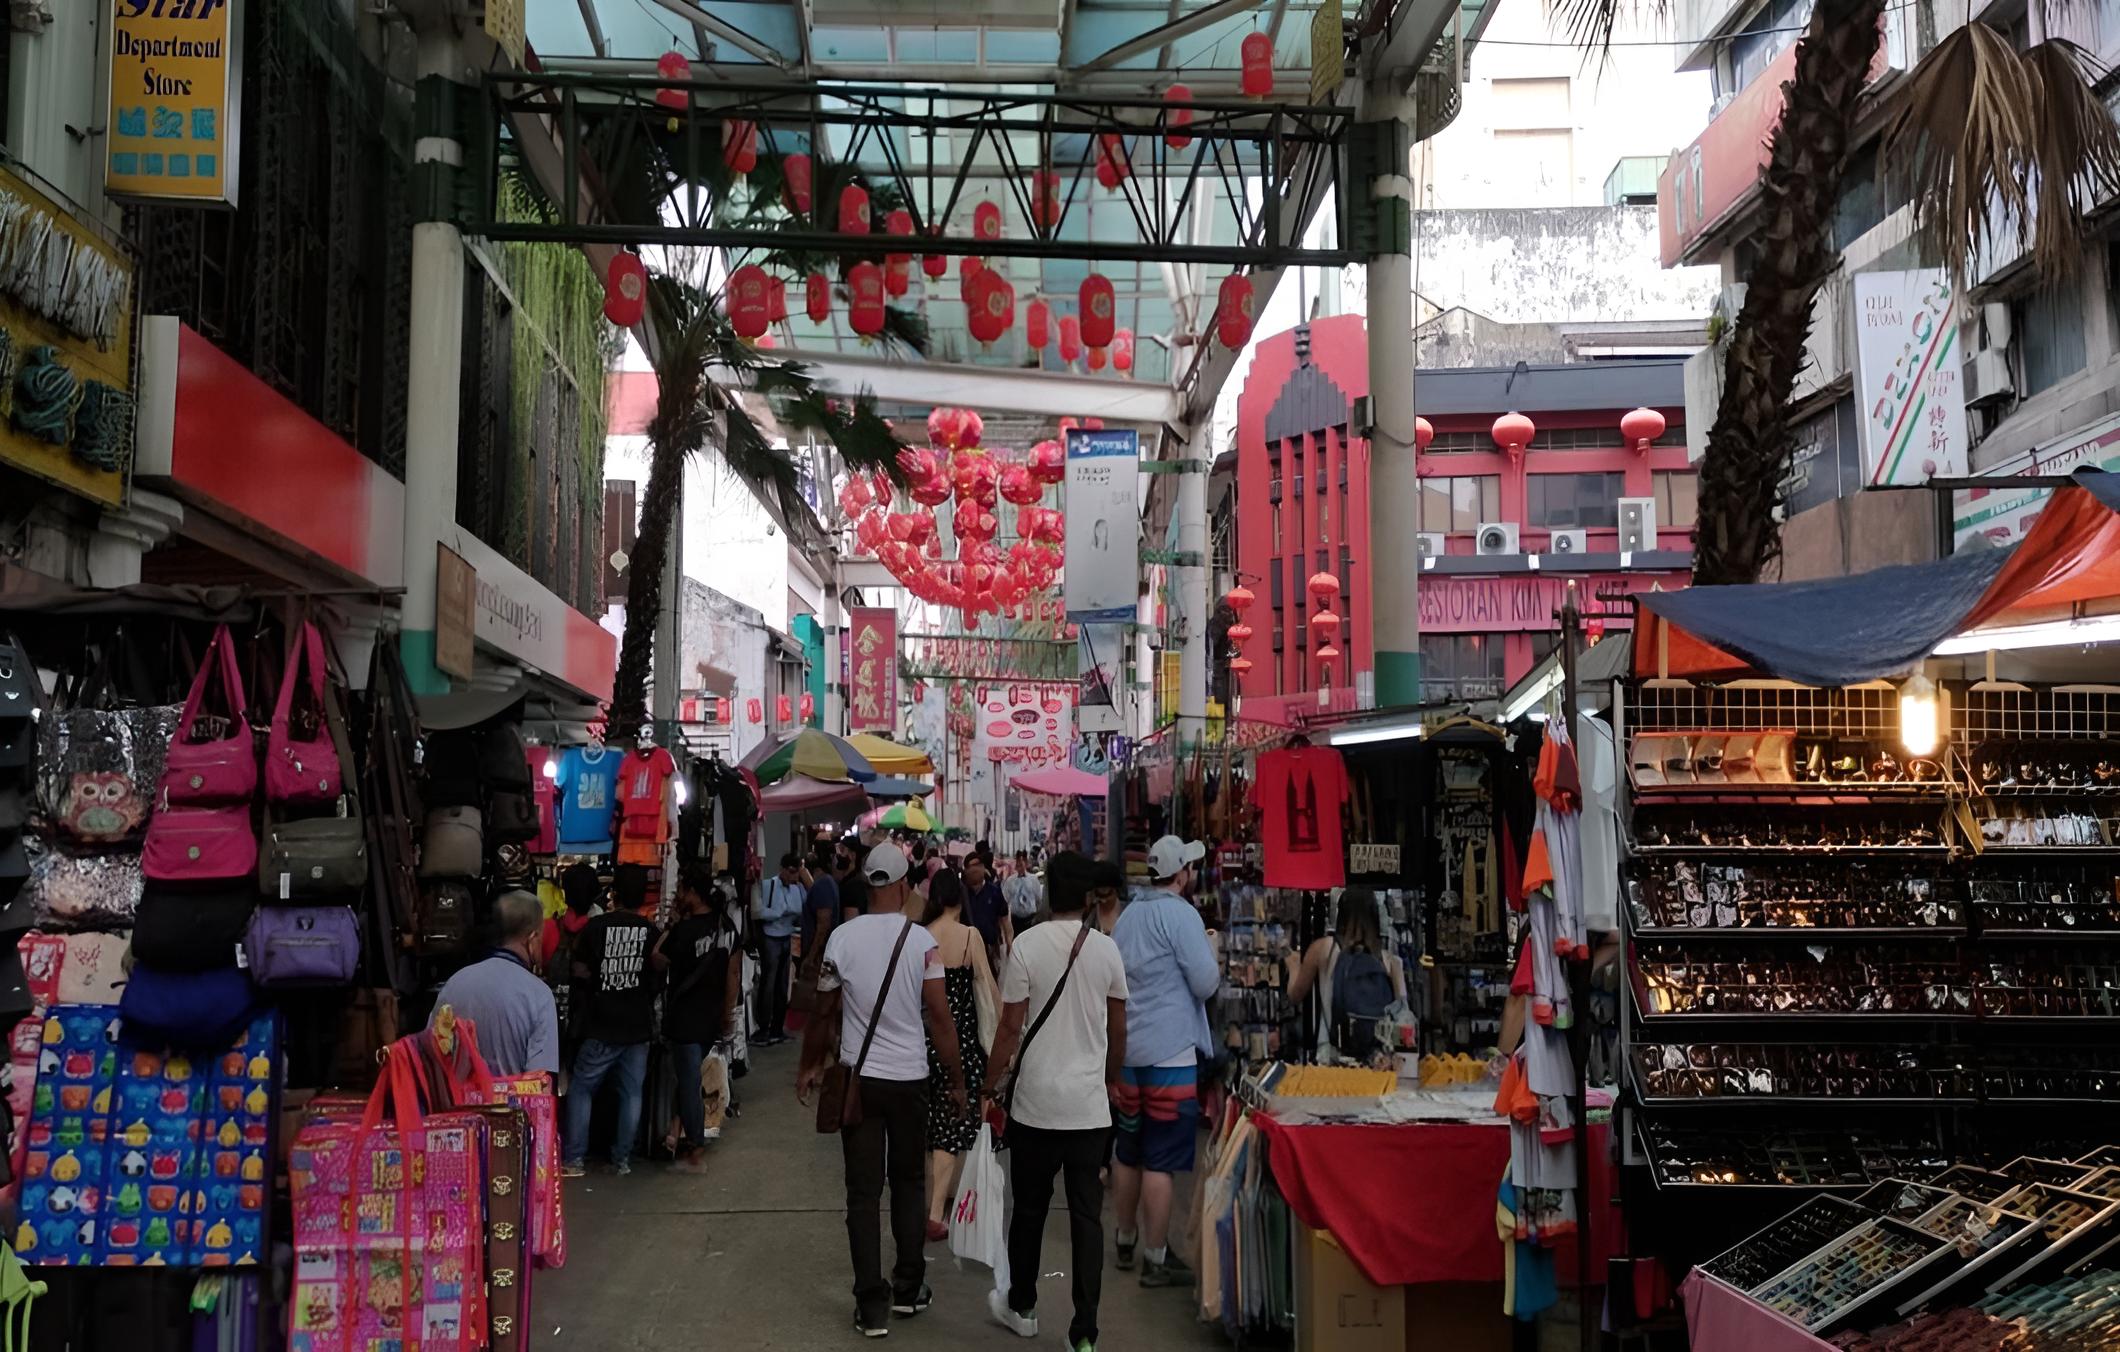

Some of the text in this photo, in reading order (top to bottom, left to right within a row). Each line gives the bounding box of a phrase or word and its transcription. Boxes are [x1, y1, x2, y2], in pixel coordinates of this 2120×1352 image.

[116, 0, 225, 20] Star
[116, 29, 221, 63] Department
[143, 66, 193, 96] Store
